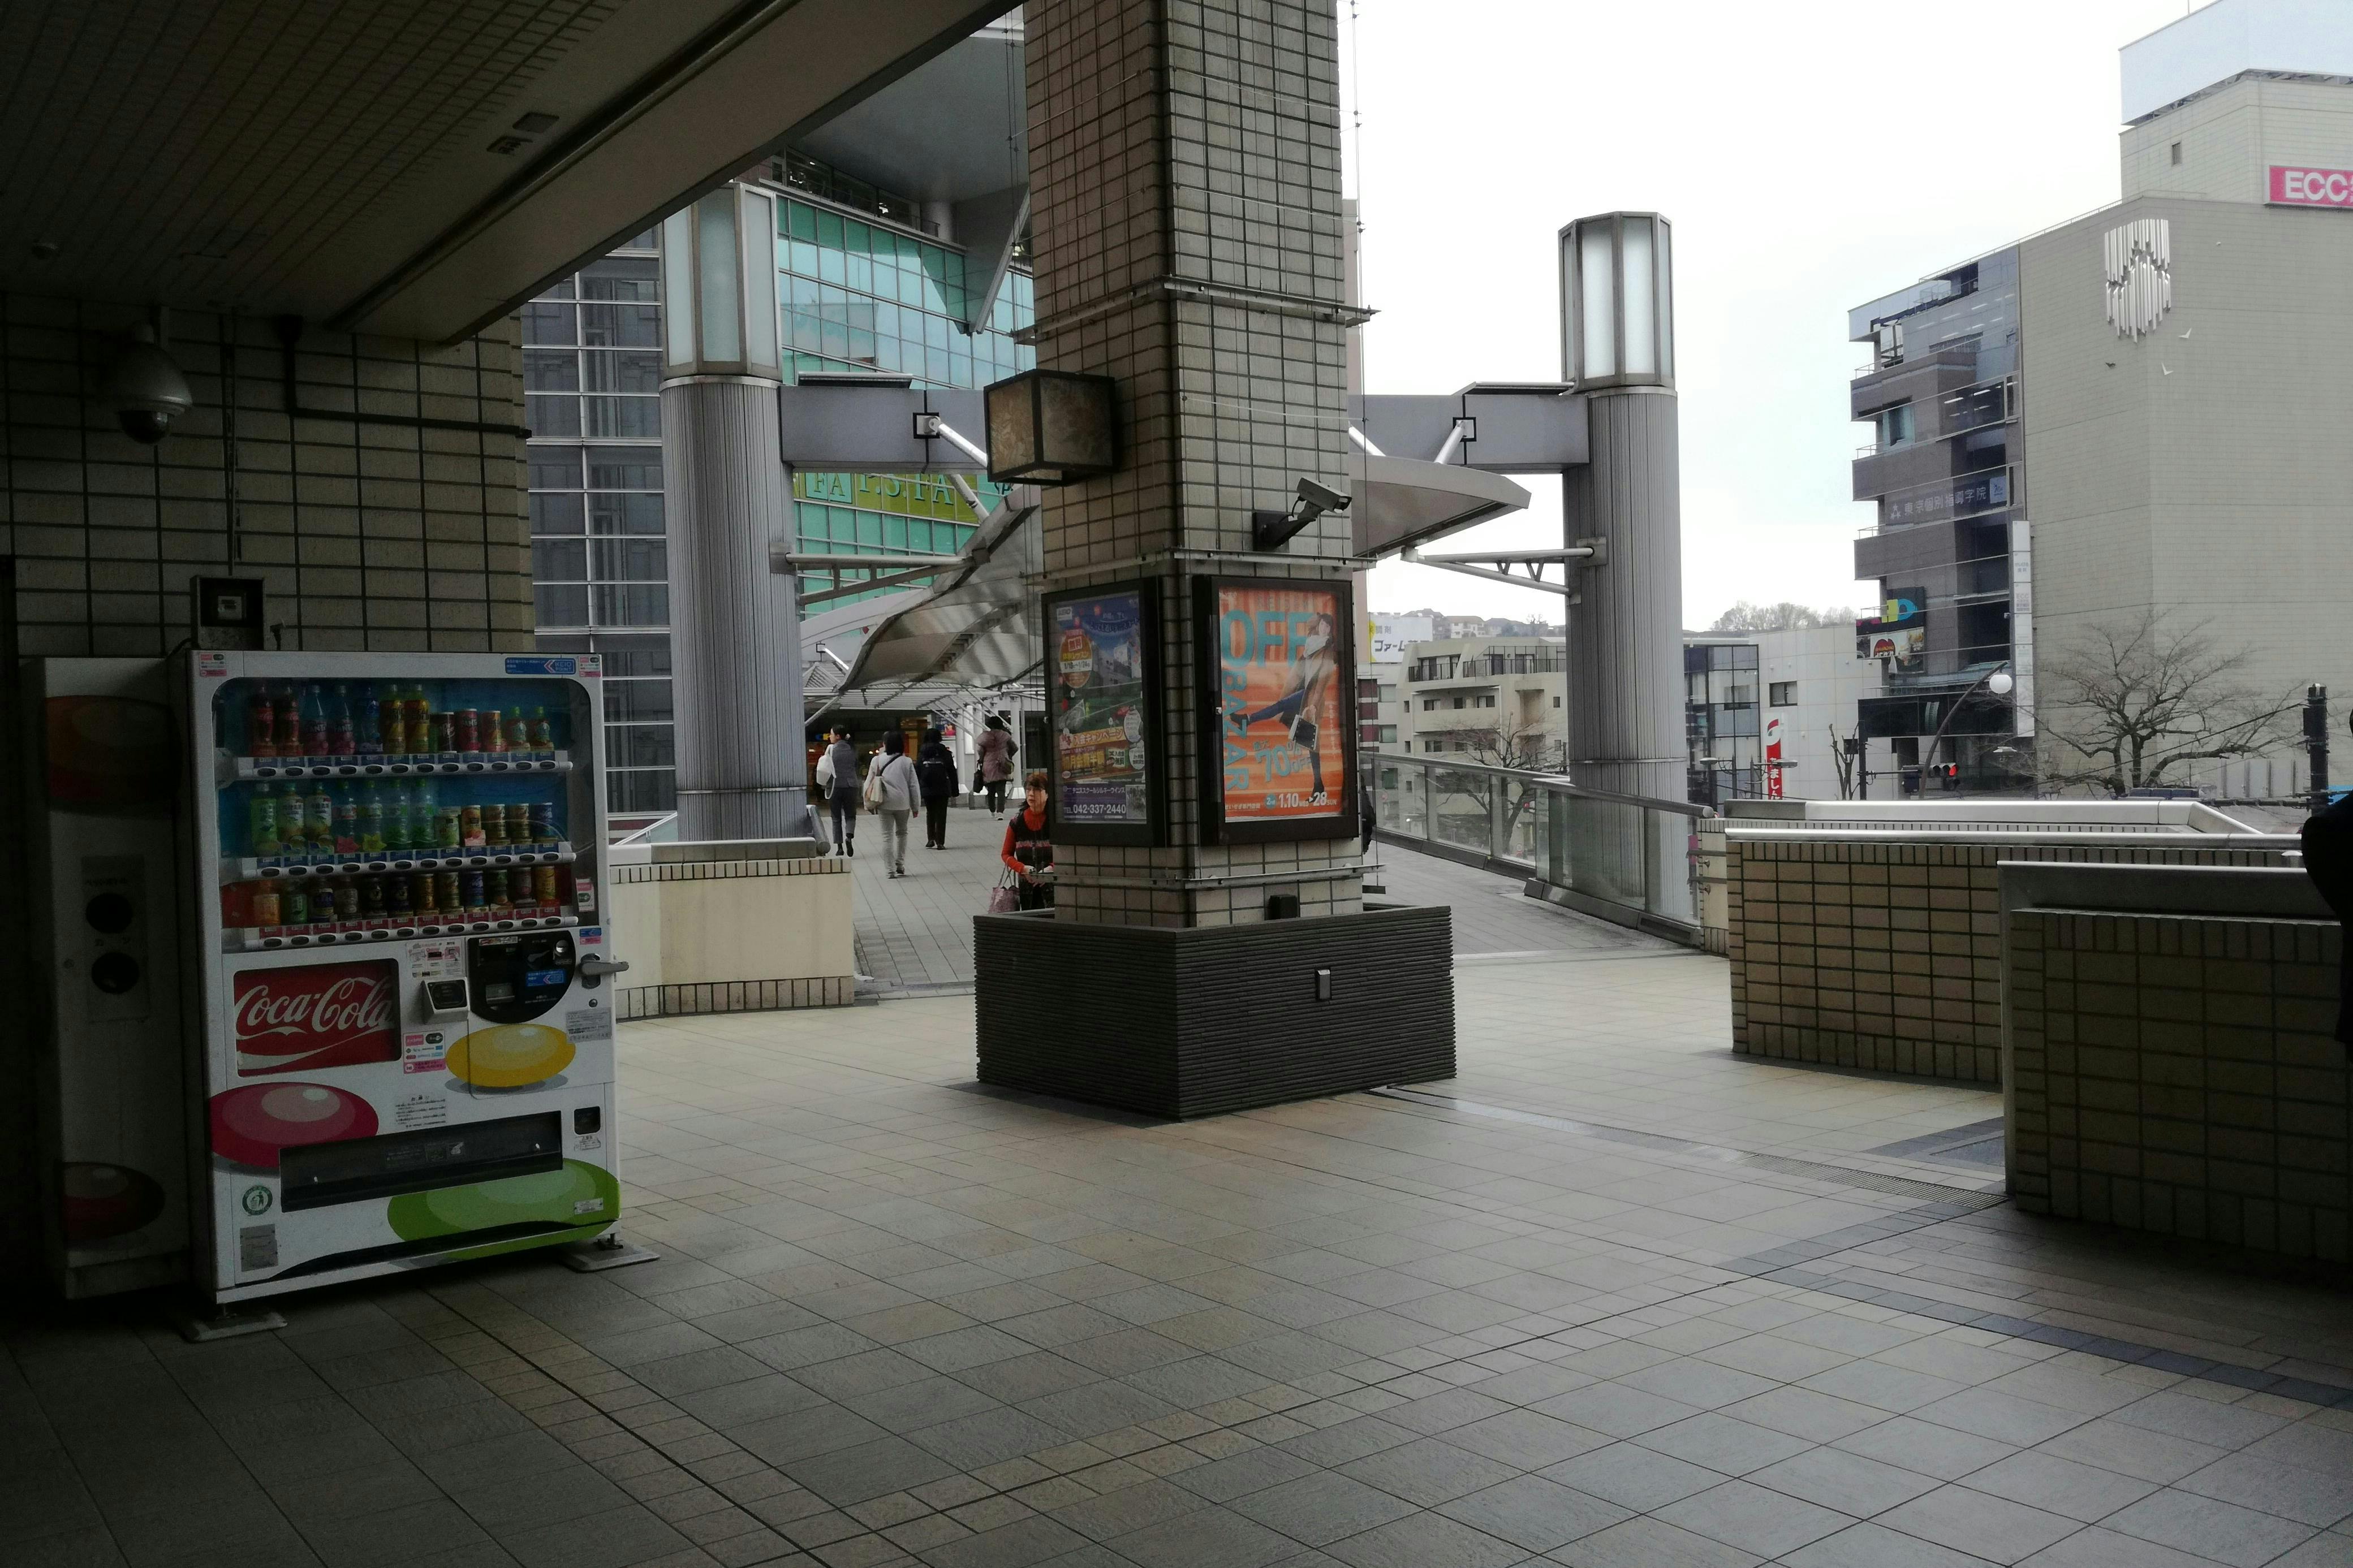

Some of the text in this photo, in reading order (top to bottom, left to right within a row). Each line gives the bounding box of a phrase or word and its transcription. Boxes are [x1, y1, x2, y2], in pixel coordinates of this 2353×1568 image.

[2285, 171, 2348, 202] ECC
[1221, 609, 1315, 668] OFF
[1222, 670, 1249, 791] BAZAR
[1278, 793, 1299, 809] 1.10
[1313, 791, 1328, 806] 28
[234, 976, 394, 1040] Coca-Cola
